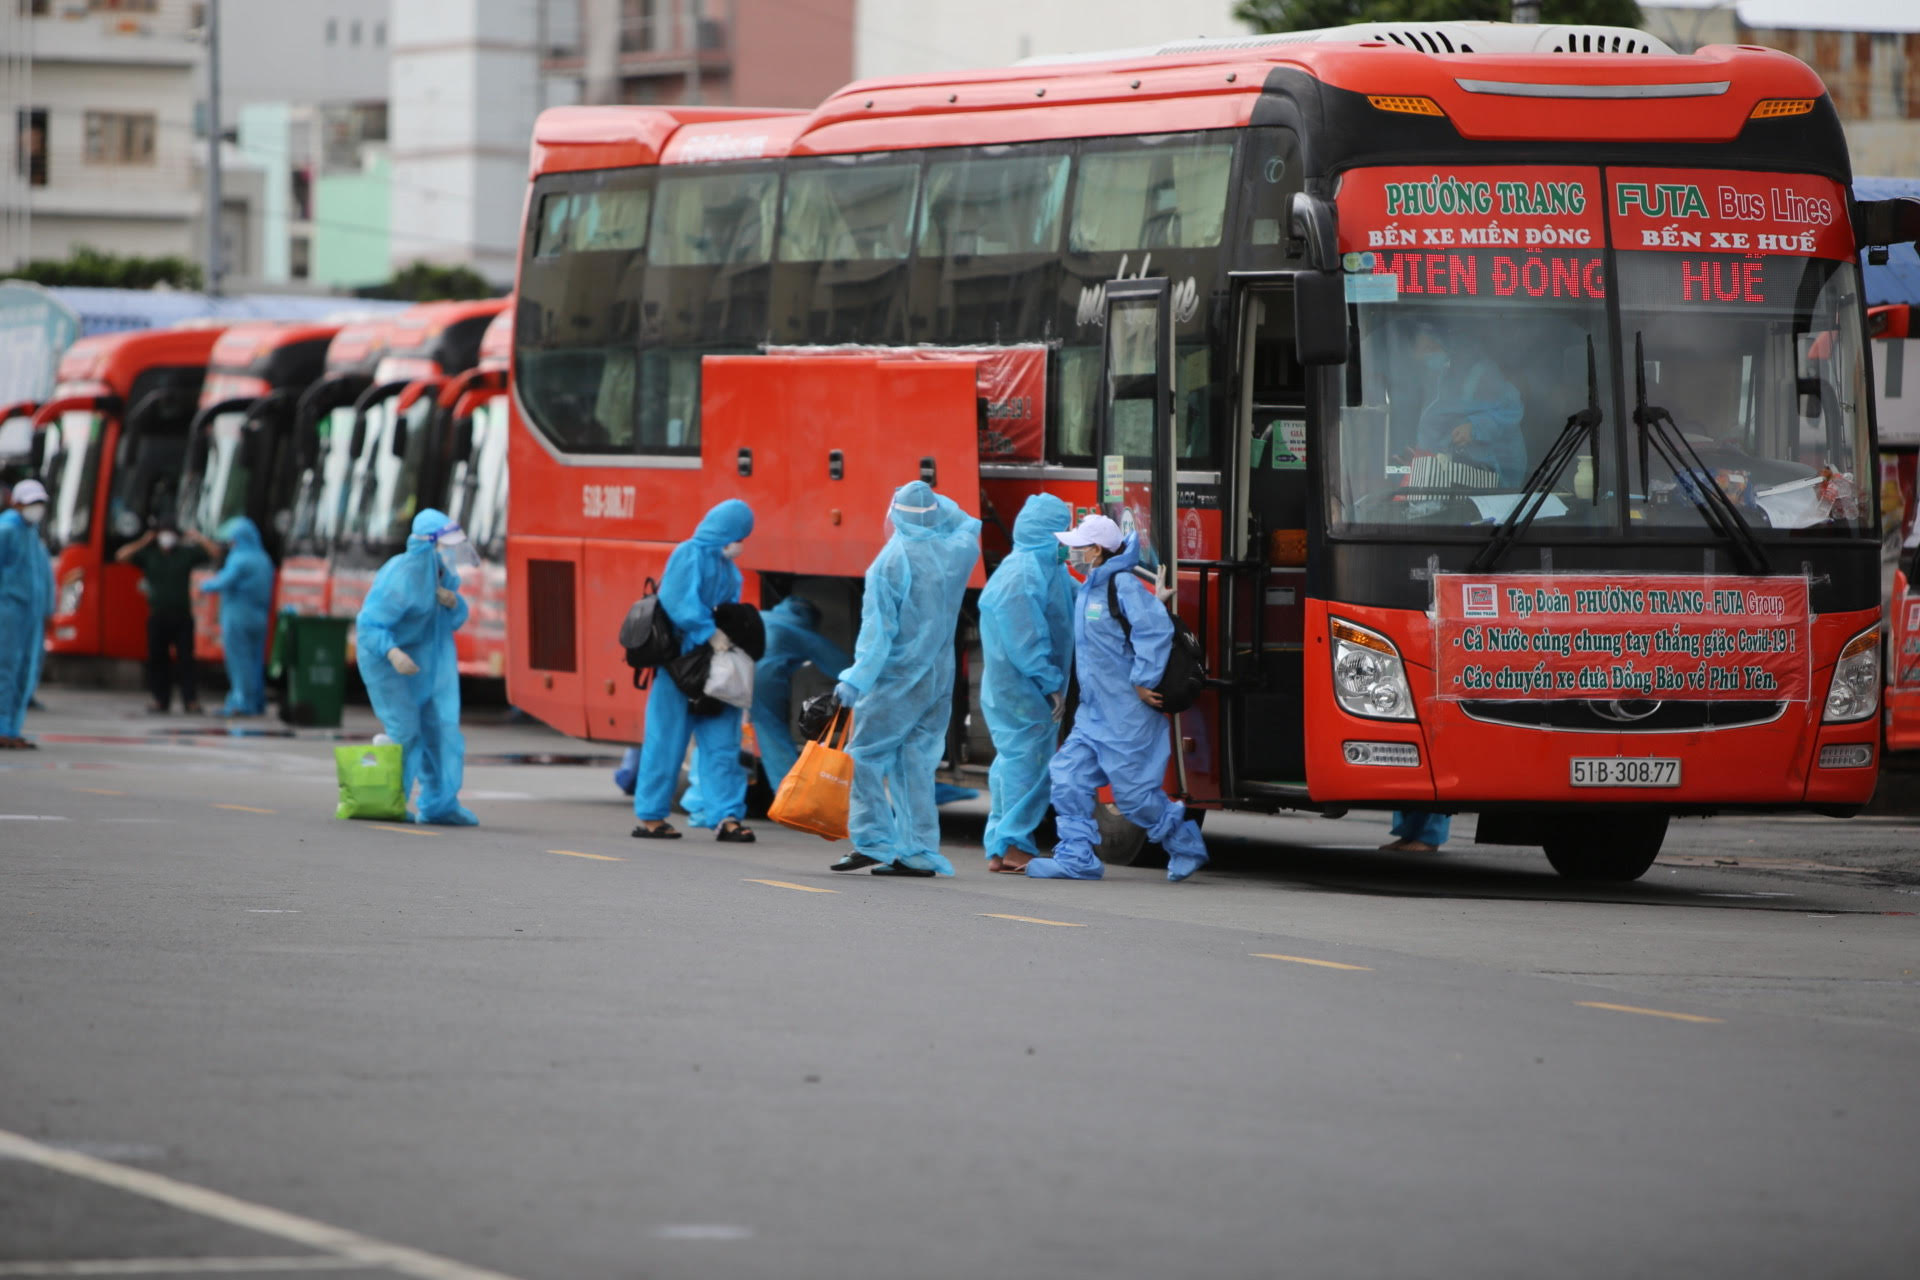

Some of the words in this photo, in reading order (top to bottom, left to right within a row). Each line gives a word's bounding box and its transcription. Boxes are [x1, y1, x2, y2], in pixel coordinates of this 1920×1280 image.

[1384, 174, 1493, 216] PHƯƠNG
[1496, 182, 1586, 215] TRANG
[1616, 183, 1710, 219] FUTA
[1718, 186, 1766, 221] Bus
[1771, 187, 1833, 226] Lines
[1368, 222, 1417, 247] BẾN
[1423, 229, 1456, 245] XE
[1460, 220, 1519, 244] MIỀN
[1525, 224, 1592, 245] ĐÔNG
[1641, 224, 1702, 248] BẾN
[1710, 232, 1750, 249] XE
[1757, 230, 1817, 252] HUẾ
[1507, 588, 1532, 619] Tập
[1536, 586, 1569, 613] Đoàn
[1576, 585, 1644, 614] PHƯƠNG
[1648, 590, 1703, 614] TRANG
[1713, 591, 1745, 615] FUTA
[1747, 591, 1784, 621] Group
[1463, 626, 1484, 651] Cả
[1487, 627, 1529, 651] Nước
[1532, 628, 1570, 656] cùng
[1574, 629, 1622, 657] chung
[1625, 631, 1651, 656] tay
[1654, 623, 1700, 657] thắng
[1703, 628, 1735, 656] giặc
[1738, 629, 1787, 652] Covid-19
[1463, 664, 1491, 689] Các
[1495, 662, 1553, 694] chuyến
[1556, 671, 1575, 689] xe
[1579, 666, 1608, 689] đưa
[1611, 661, 1652, 694] Đồng
[1655, 665, 1684, 689] Bào
[1688, 661, 1706, 689] về
[1708, 666, 1739, 690] Phú
[1742, 666, 1778, 690] Yên.
[1574, 761, 1677, 783] 51B-308.77
